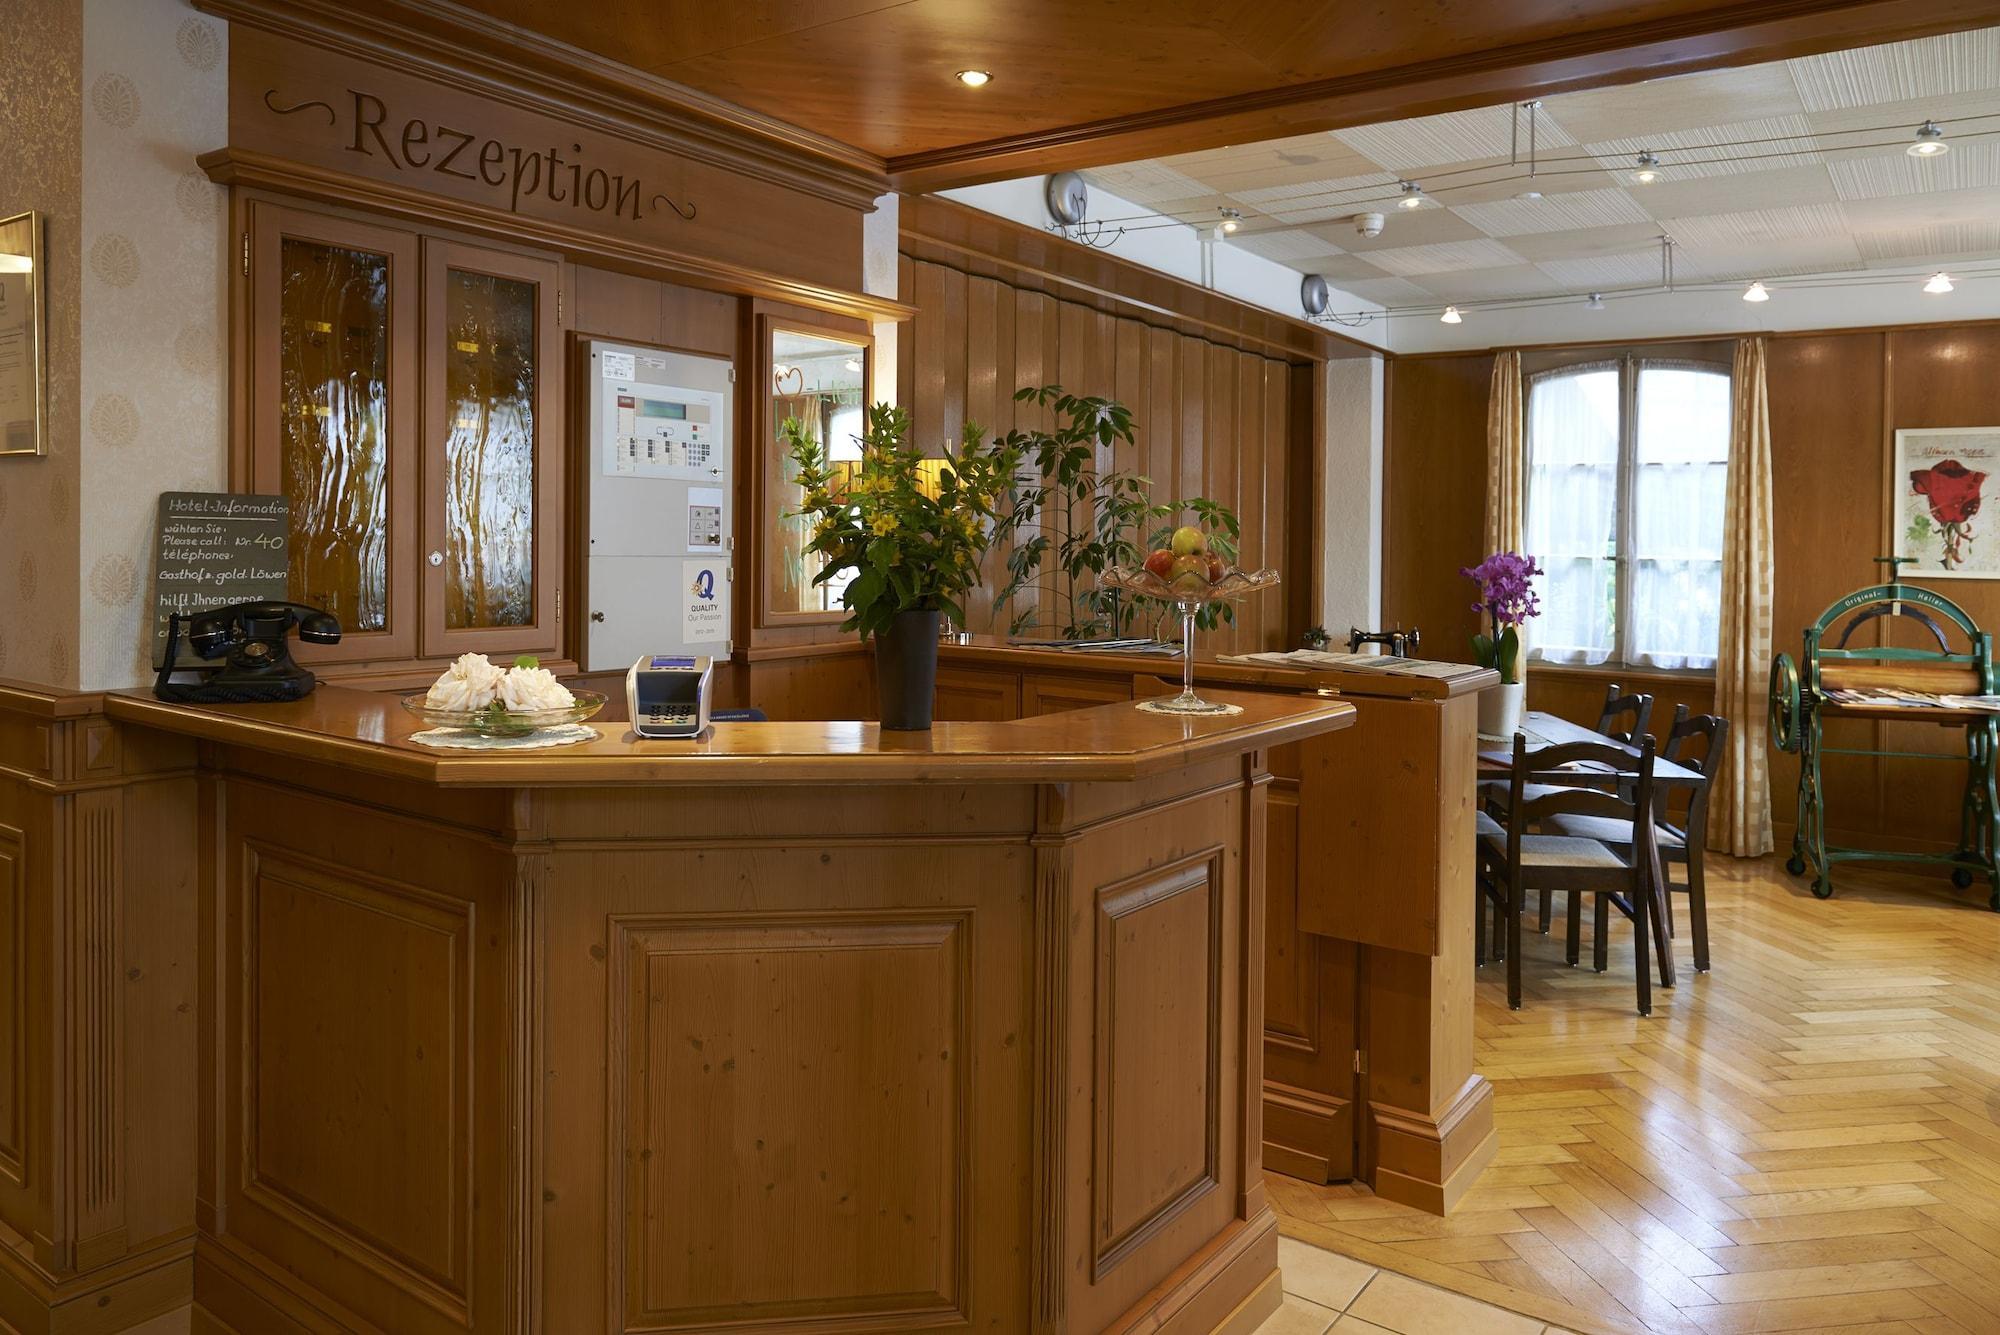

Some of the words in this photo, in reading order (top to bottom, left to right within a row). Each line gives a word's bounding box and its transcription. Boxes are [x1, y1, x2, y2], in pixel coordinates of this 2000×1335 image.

[346, 89, 642, 220] Rezeption
[162, 535, 198, 546] Please
[254, 532, 284, 550] 40
[697, 569, 714, 600] Q
[160, 592, 188, 611] hilft
[691, 604, 719, 612] QUALITY
[688, 614, 699, 622] Our
[700, 613, 722, 621] Passion
